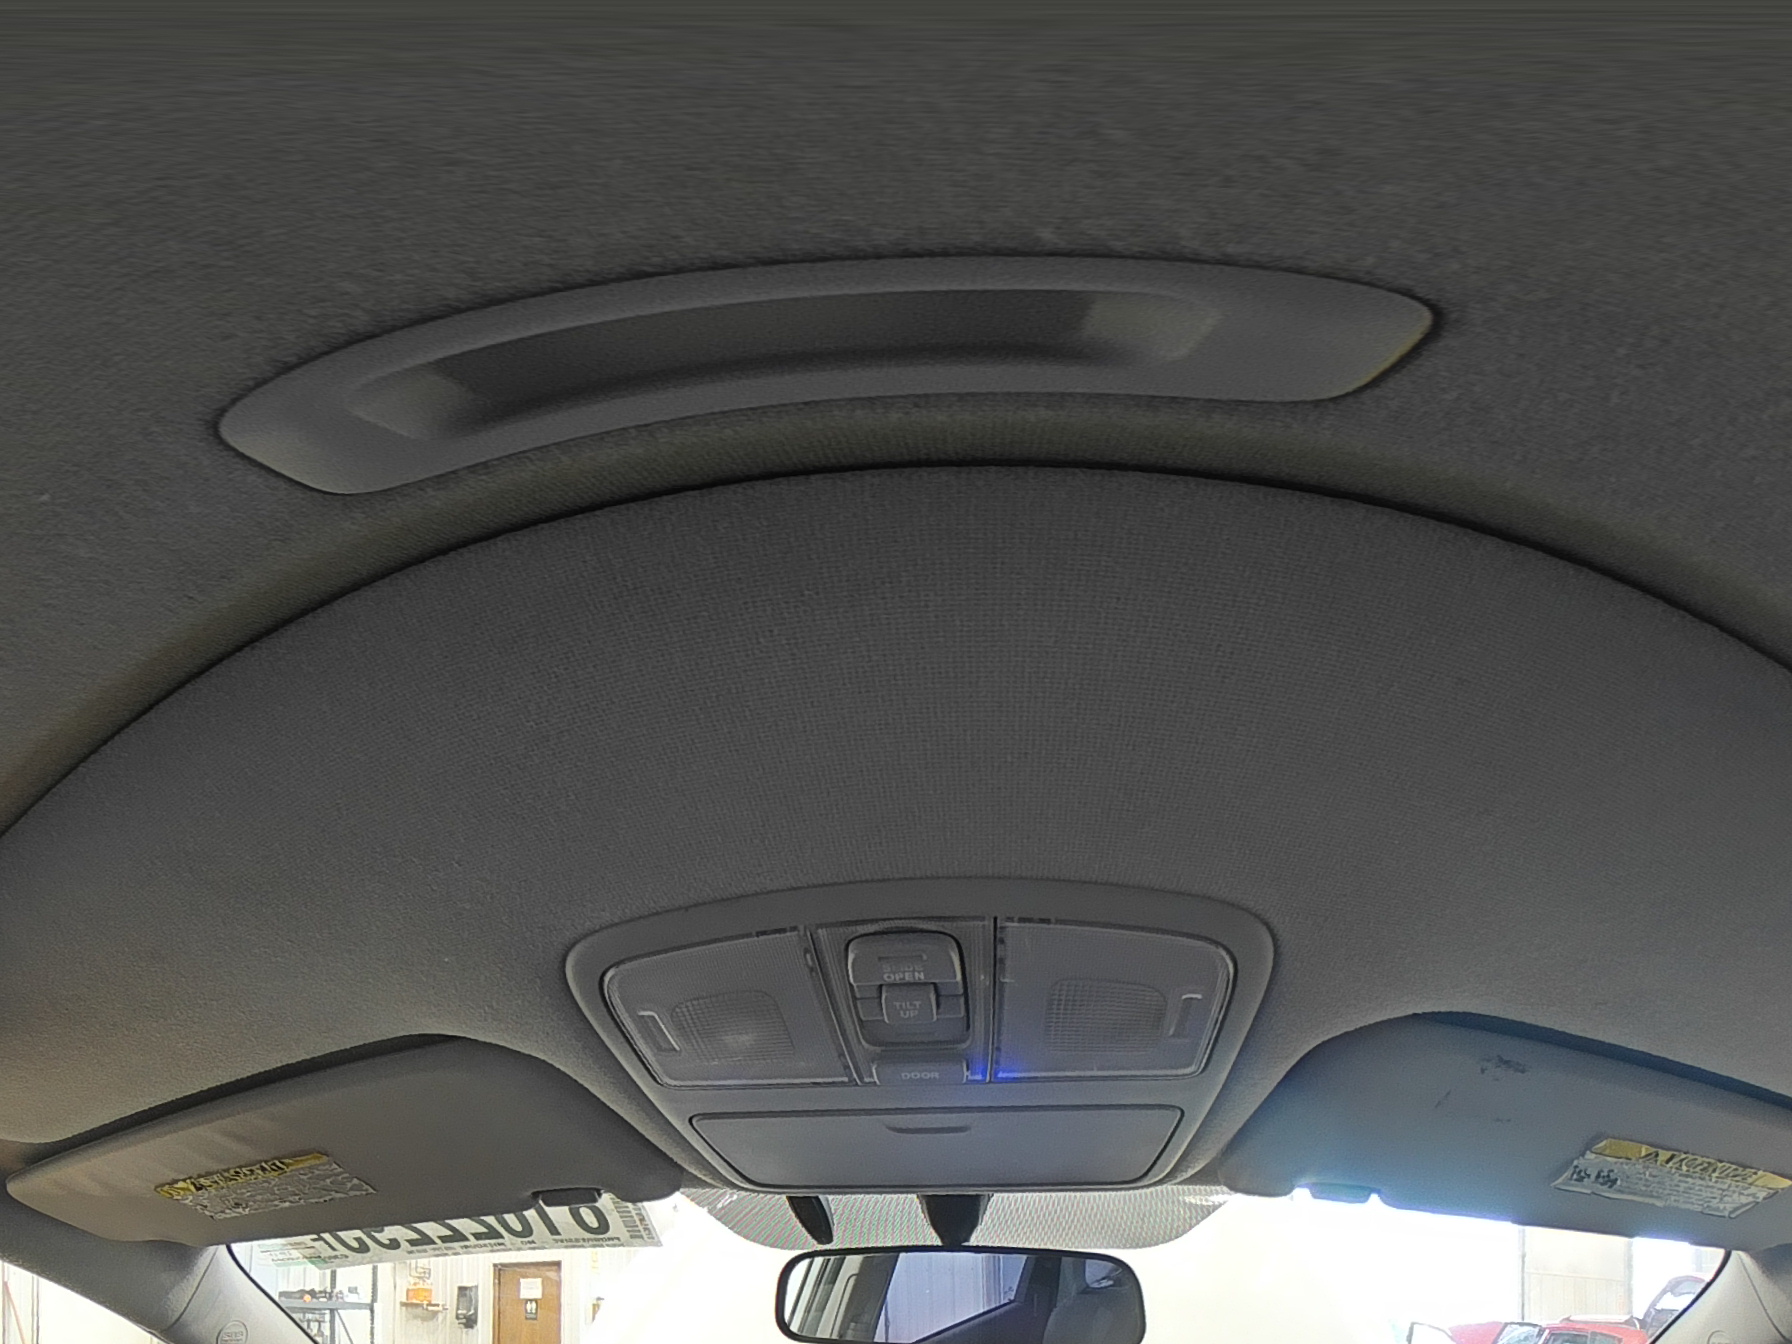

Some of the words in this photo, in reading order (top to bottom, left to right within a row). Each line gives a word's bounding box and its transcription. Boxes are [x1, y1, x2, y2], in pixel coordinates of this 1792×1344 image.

[882, 971, 925, 982] OPEN
[893, 1001, 922, 1010] TILT
[899, 1010, 919, 1019] UP
[900, 1071, 940, 1080] DOOR
